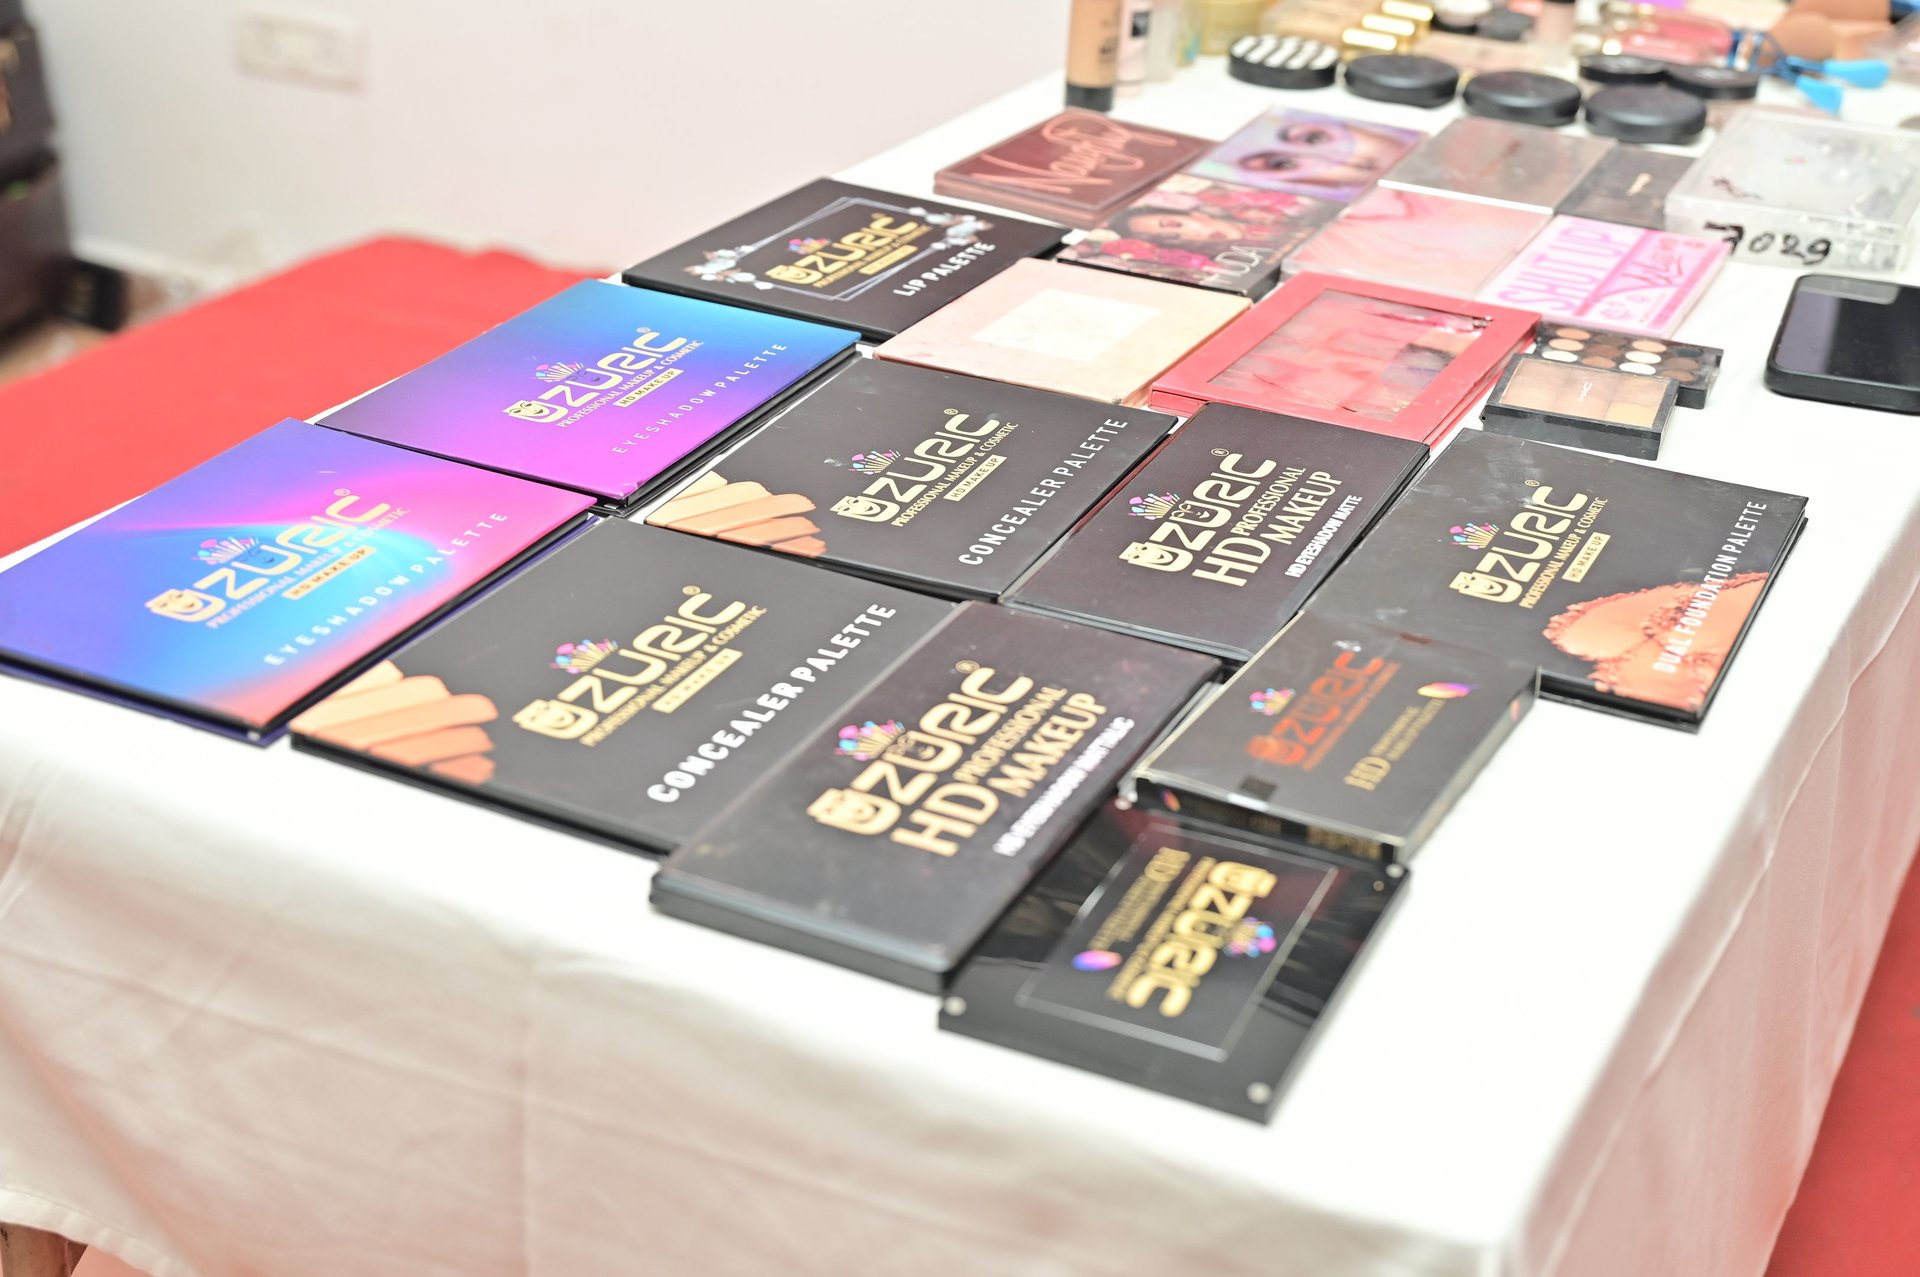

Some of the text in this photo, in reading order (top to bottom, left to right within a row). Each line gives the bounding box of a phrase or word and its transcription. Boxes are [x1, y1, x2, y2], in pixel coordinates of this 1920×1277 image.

[893, 270, 927, 297] LIP
[920, 242, 996, 285] PALETTE
[1497, 227, 1630, 311] SHUT UP
[556, 391, 623, 428] PROFESSIONAL
[619, 369, 655, 391] MAKEUP
[660, 340, 704, 366] COSMETIC
[612, 343, 788, 455] EYESHADOW PALETTE
[619, 370, 676, 405] HD MAKE UP
[891, 482, 951, 527] PROFESSIONAL
[944, 456, 978, 482] MAKEUP
[980, 422, 1019, 452] COSMETIC
[951, 457, 998, 498] HD MAKE UP
[958, 418, 1128, 566] CONCEALER PALETTE
[1230, 466, 1306, 536] PROFESSIONAL
[1192, 471, 1343, 587] HD MAKEUP
[1284, 494, 1363, 578] HD EYESHADOW MATTE
[1519, 561, 1564, 609] PROFESSIONAL
[1554, 533, 1581, 561] MAKEUP
[1577, 496, 1608, 528] COSMETIC
[1569, 535, 1603, 579] HD MAKE UP
[263, 512, 508, 667] EYESHADOW PALETTE
[1652, 501, 1767, 673] DUAL FOUNDATION PALETTE
[646, 681, 805, 803] CONCEALER
[790, 603, 897, 683] PALETTE
[953, 686, 1068, 785] PROFESSIONAL
[890, 692, 1107, 857] HD MAKEUP
